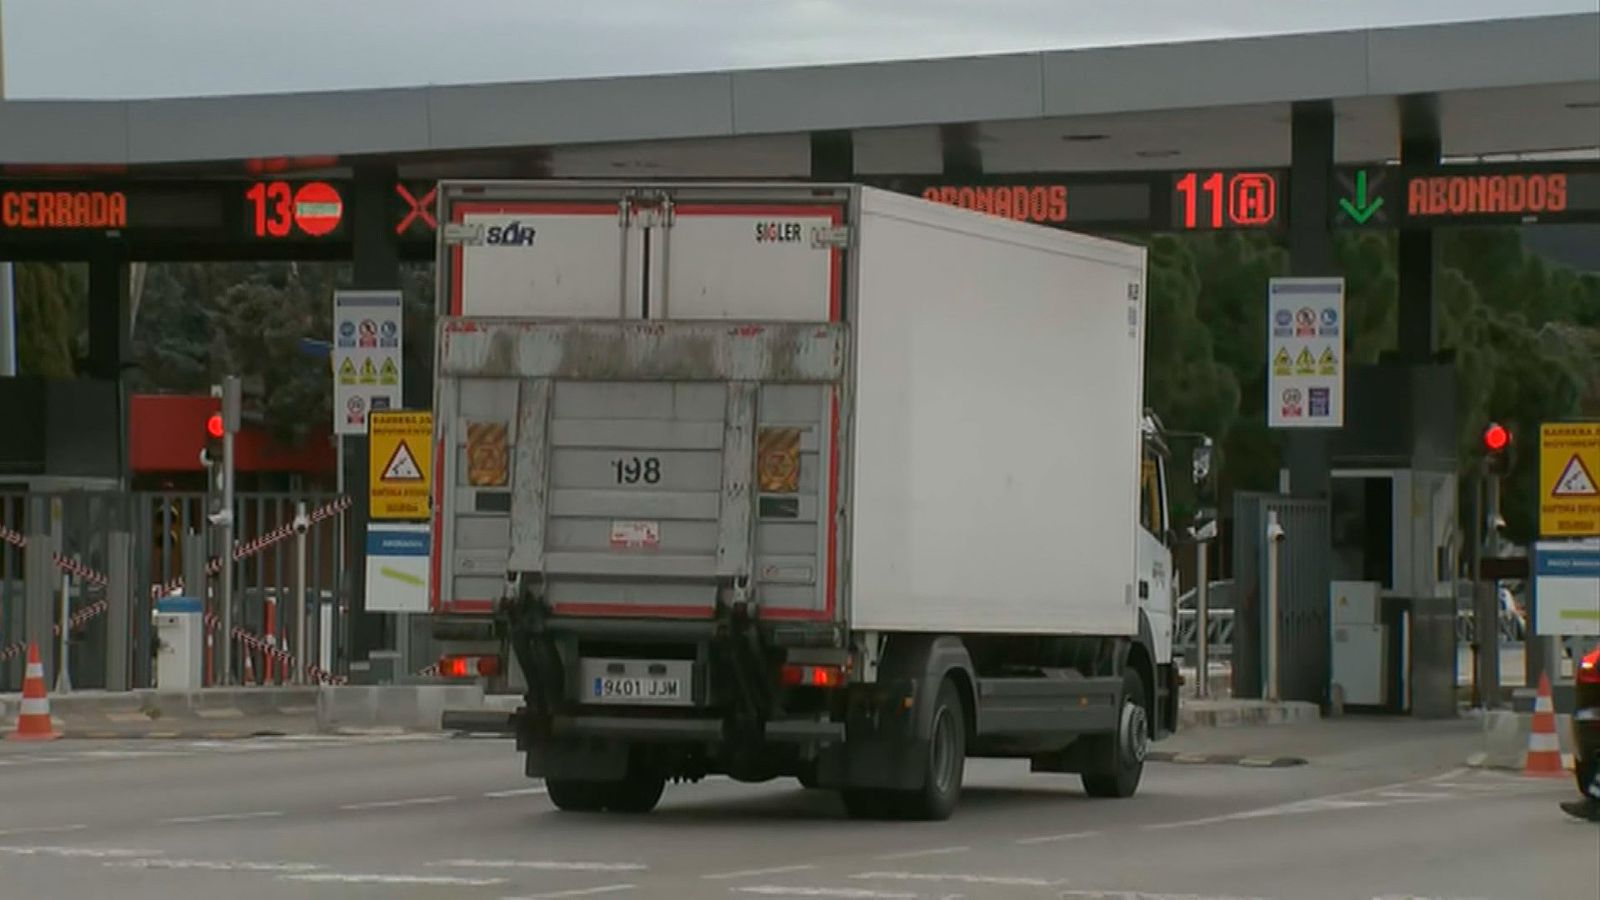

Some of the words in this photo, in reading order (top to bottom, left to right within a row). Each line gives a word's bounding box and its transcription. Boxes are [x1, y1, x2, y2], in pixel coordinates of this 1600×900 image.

[2, 191, 127, 229] CERRADA
[247, 182, 291, 236] 13
[1176, 172, 1223, 229] 11
[1407, 173, 1567, 216] ABONADOS
[756, 222, 801, 243] SIGLER
[610, 457, 660, 484] 198
[604, 679, 640, 696] 9401
